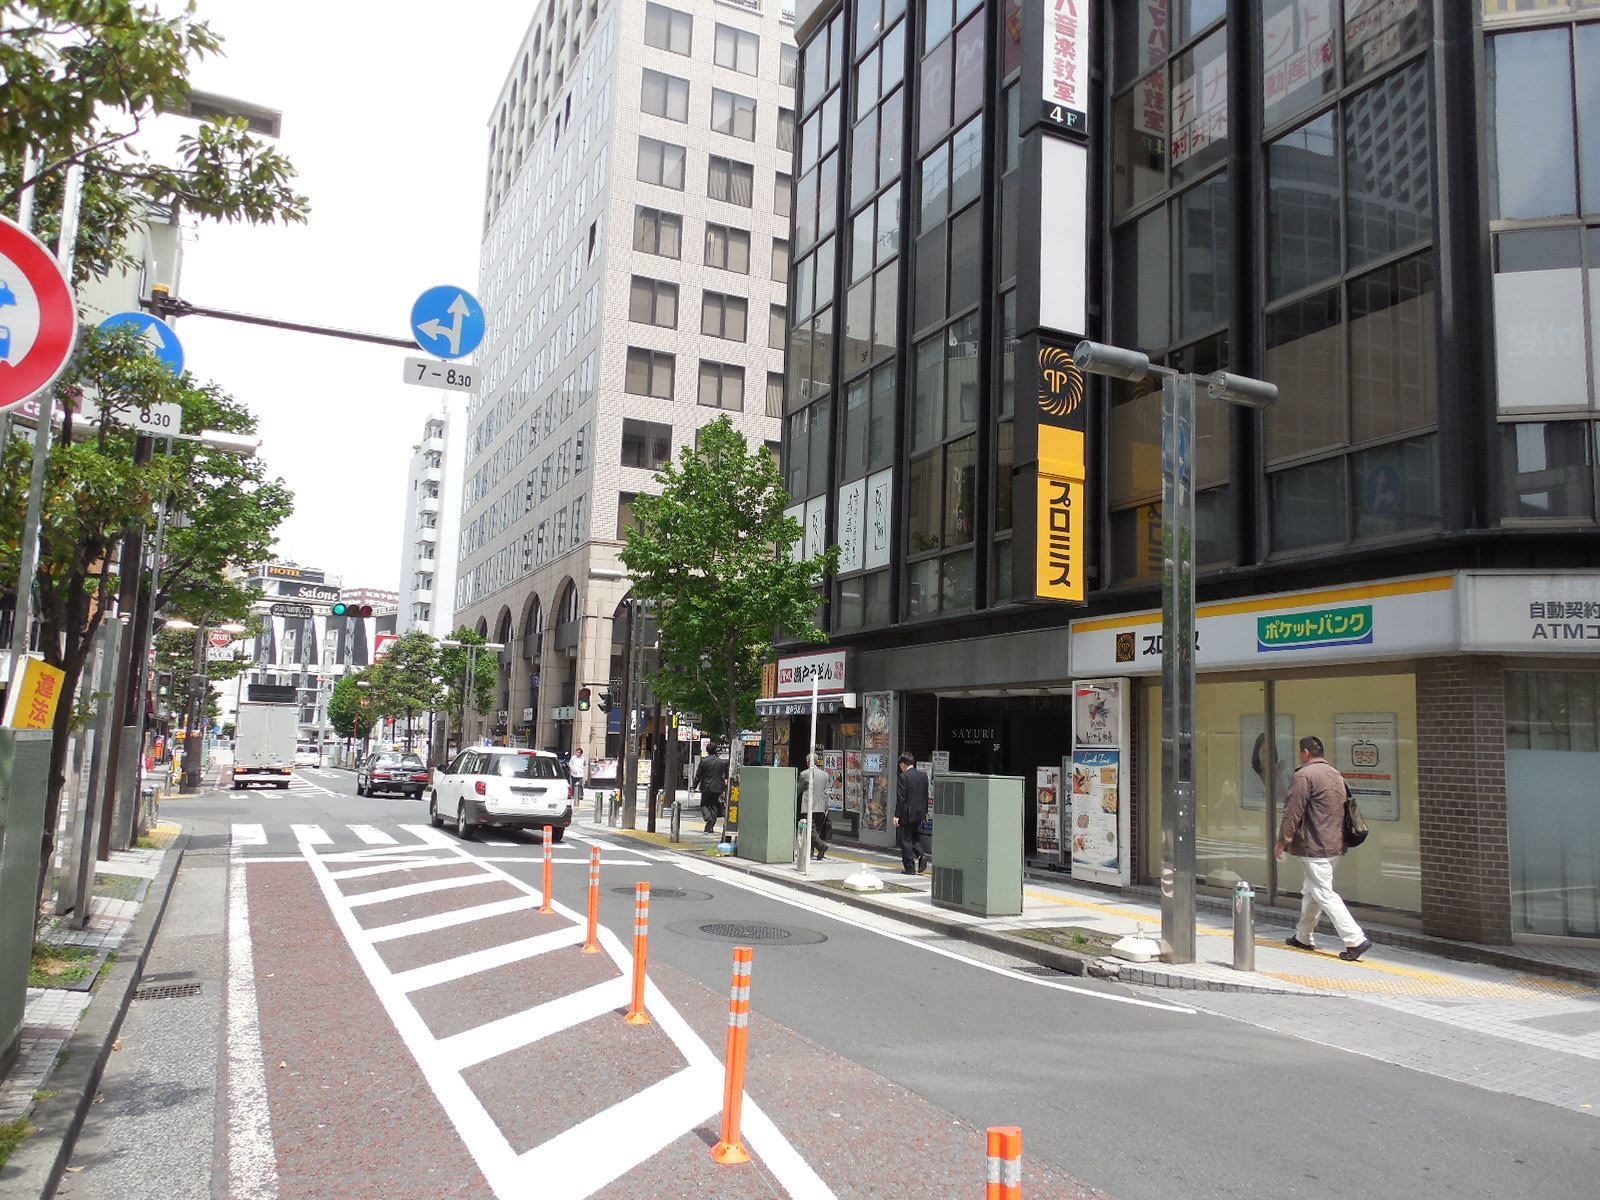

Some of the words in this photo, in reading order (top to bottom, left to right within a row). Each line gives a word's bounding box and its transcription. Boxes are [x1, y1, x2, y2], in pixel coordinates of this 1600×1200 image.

[1049, 481, 1071, 587] プロミス
[269, 567, 301, 577] HOTEL
[298, 587, 338, 601] Salone
[1265, 612, 1365, 640] ポケットバンク
[794, 662, 833, 683] 瀬戸うどん
[951, 729, 995, 739] SAYURI
